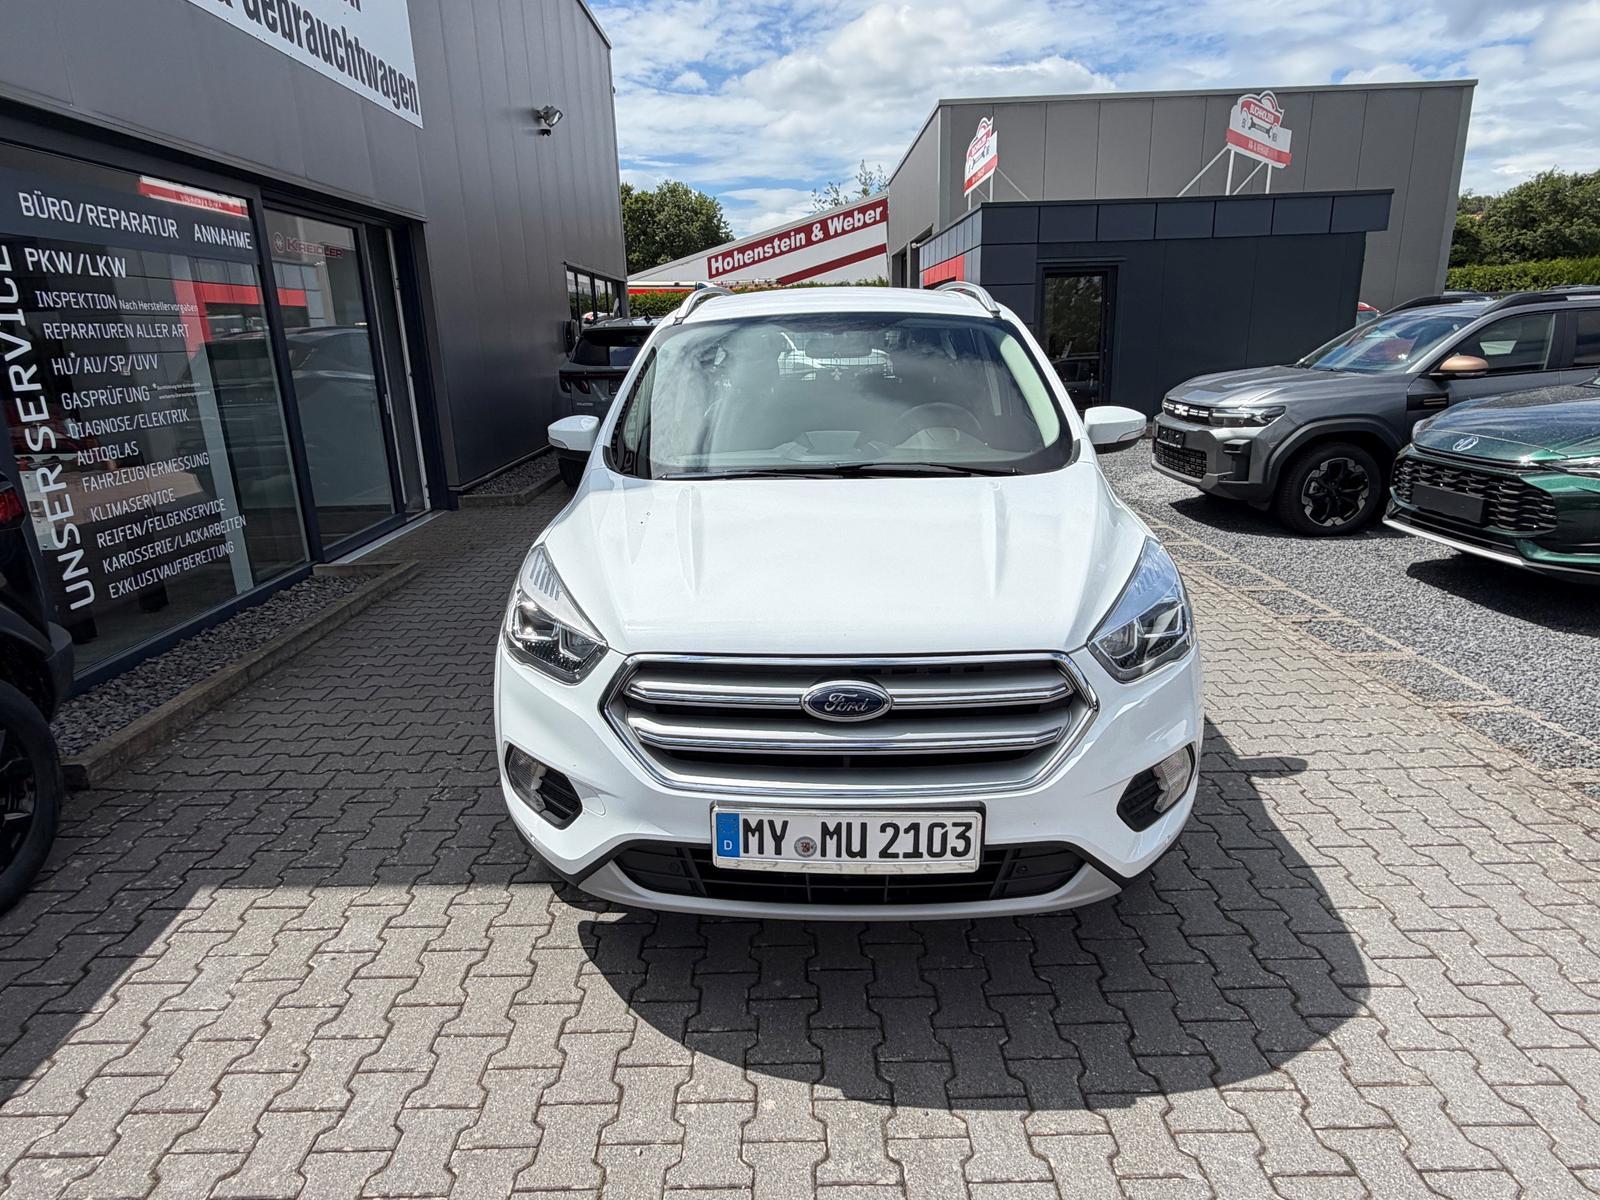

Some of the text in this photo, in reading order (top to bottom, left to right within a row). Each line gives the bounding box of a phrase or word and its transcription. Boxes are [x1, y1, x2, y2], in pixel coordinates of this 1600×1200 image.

[18, 191, 179, 239] BÜRO/REPARATUR
[194, 224, 253, 250] ANNAHME
[711, 206, 883, 275] Hohenstein & Weber
[24, 248, 127, 278] PKW/LKW
[35, 290, 118, 310] INSPEKTION
[119, 300, 137, 310] Nach
[43, 322, 190, 340] REPARATUREN ALLER ART
[61, 385, 150, 410] GASPRÜFUNG
[67, 408, 190, 439] DIAGNOSE/ELEKTRIK
[77, 441, 139, 466] AUTOGLAS
[82, 452, 210, 493] FAHRZEUGVERMESSUNG
[90, 488, 176, 523] KLIMASERVICE
[96, 498, 226, 548] REIFEN/FELGENSERVICE
[36, 464, 96, 610] UNSER
[102, 514, 247, 574] KAROSSERIE/LACKARBEITEN
[108, 541, 234, 599] EXKLUSIVAUFBEREITUNG
[824, 692, 869, 712] Ford
[723, 818, 973, 859] D MY MU 2103
